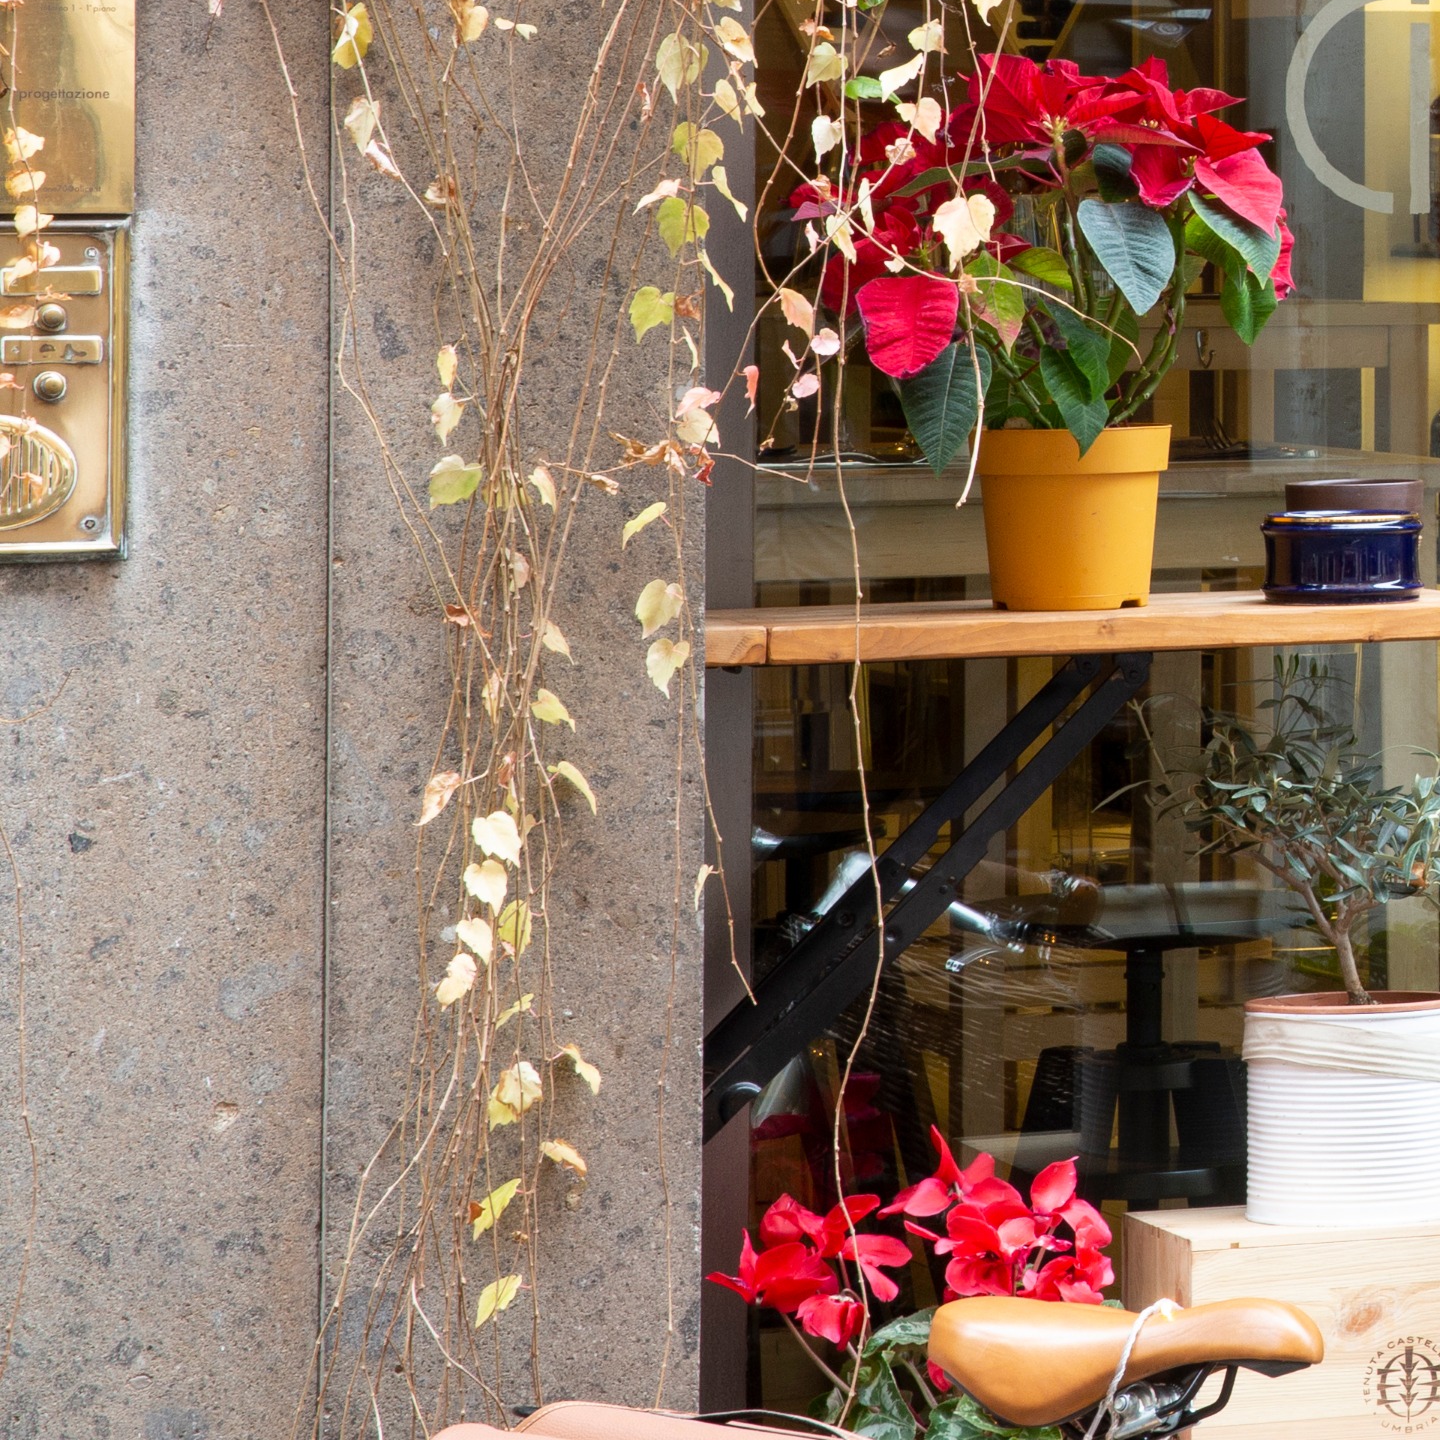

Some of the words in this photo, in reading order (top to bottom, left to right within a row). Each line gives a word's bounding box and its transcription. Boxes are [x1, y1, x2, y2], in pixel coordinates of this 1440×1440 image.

[19, 88, 110, 101] progettazione
[1362, 1350, 1385, 1406] TENUTA
[1381, 1416, 1438, 1434] UMBRIA
